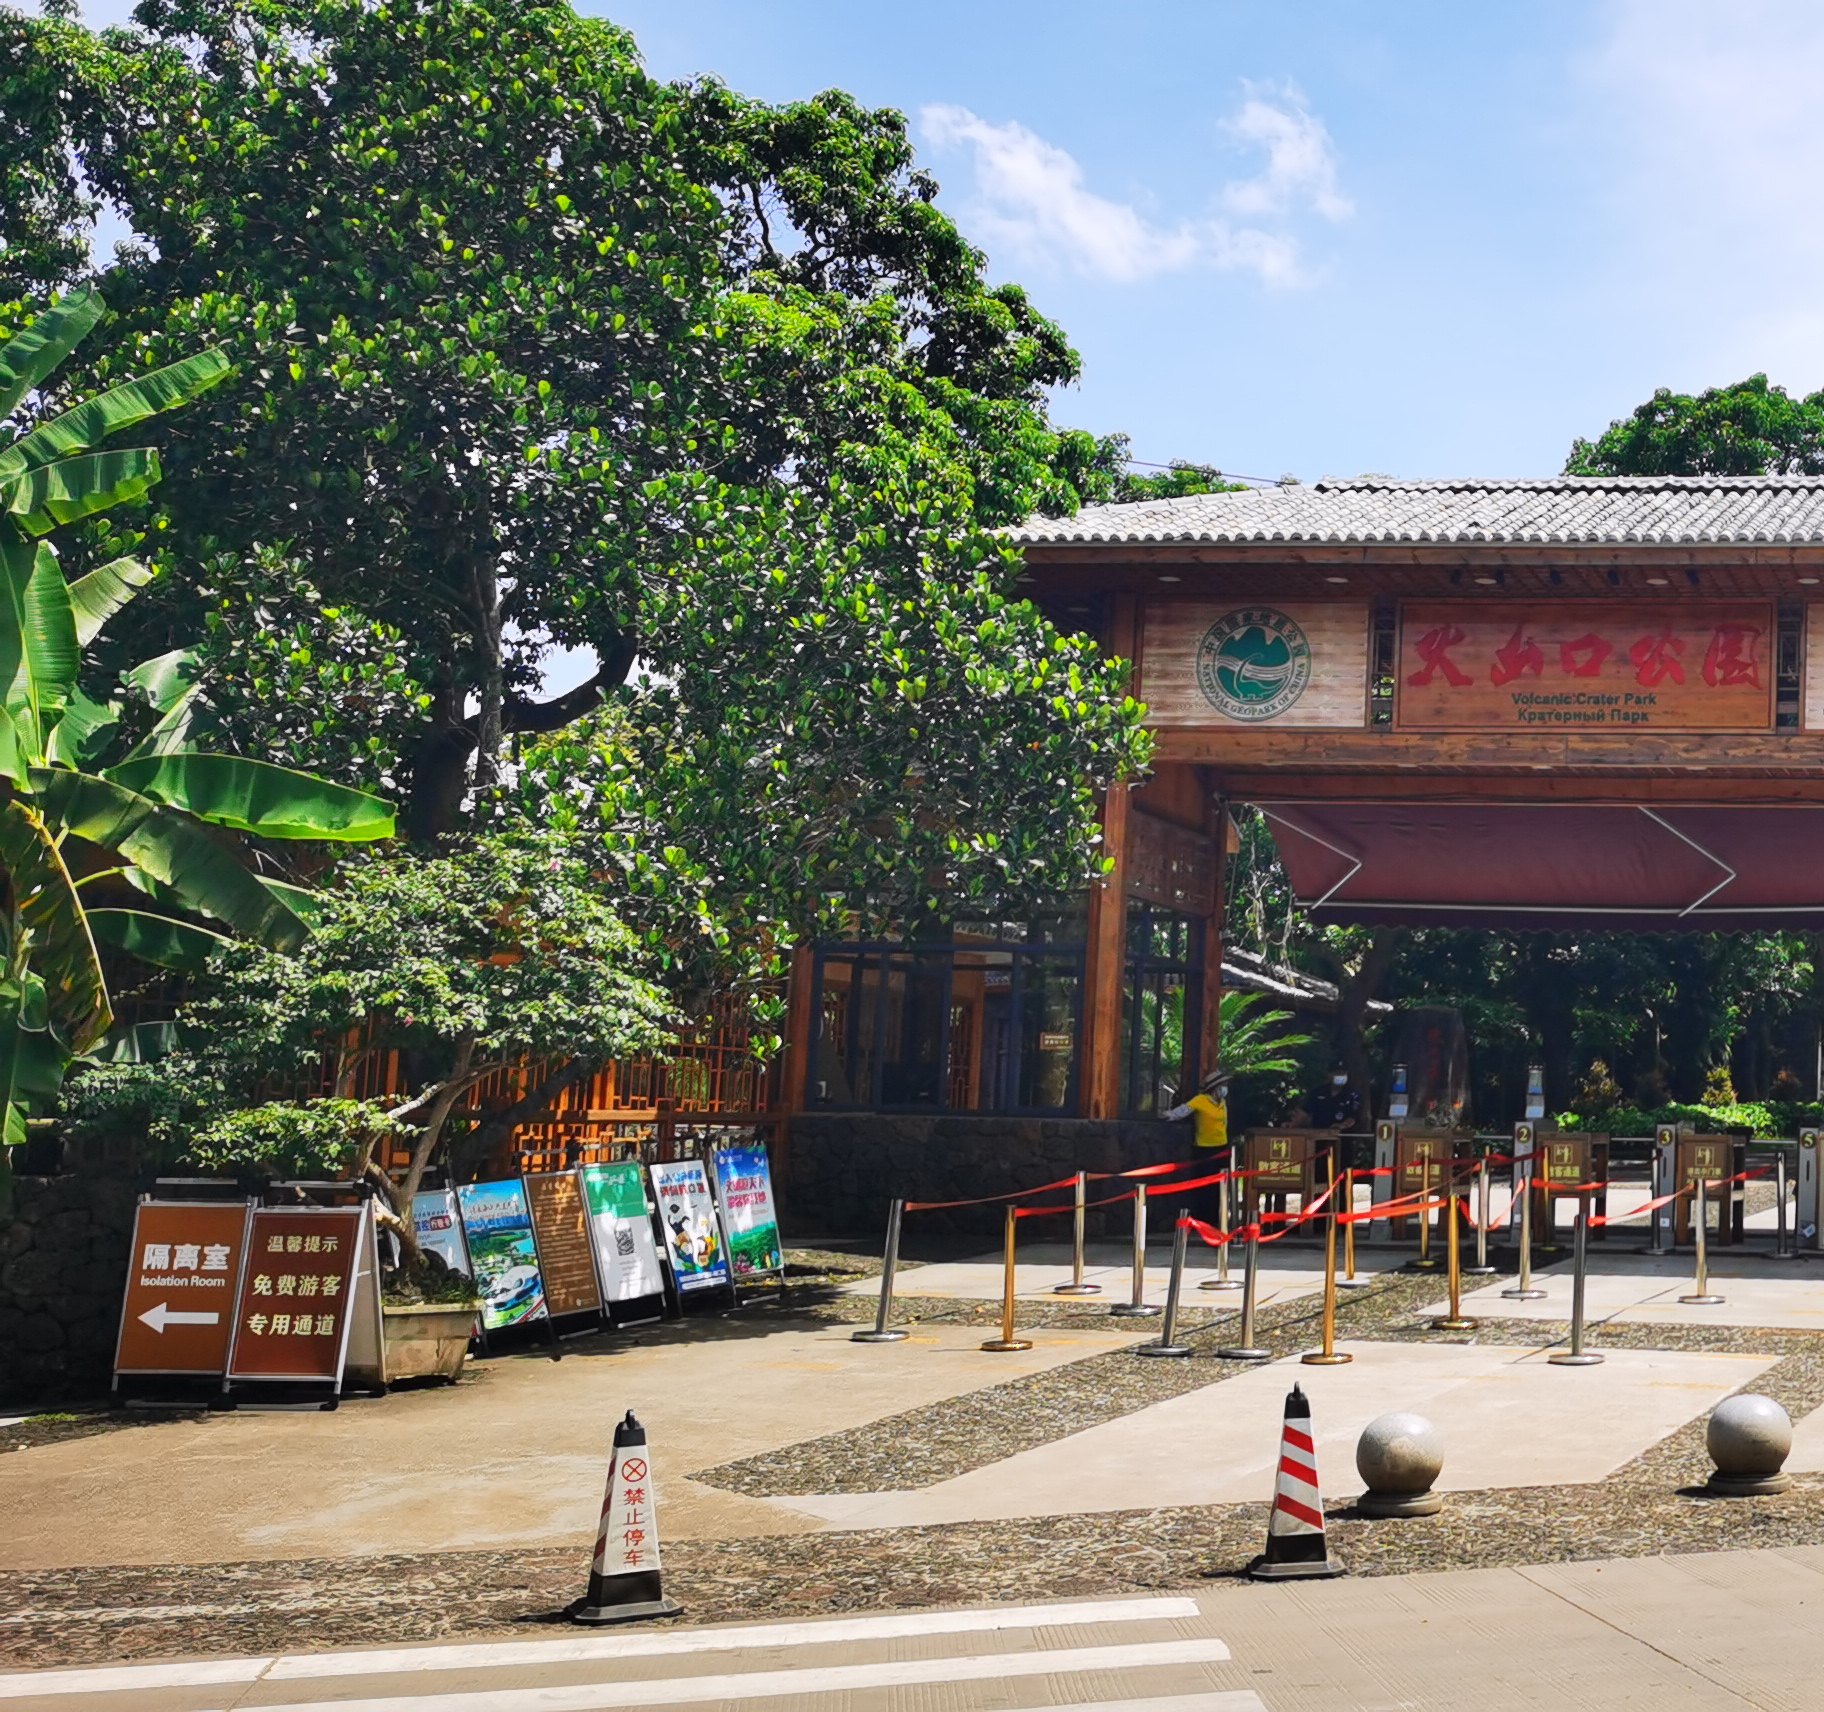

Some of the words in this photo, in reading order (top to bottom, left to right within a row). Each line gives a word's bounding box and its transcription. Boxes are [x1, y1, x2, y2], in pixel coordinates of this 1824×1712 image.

[1407, 621, 1765, 691] 火山口公园
[1230, 703, 1278, 716] GEOPARK
[1511, 692, 1572, 705] Volcanic
[1577, 692, 1620, 705] Crater
[1625, 692, 1657, 705] Park
[1518, 708, 1605, 723] Кратерный
[1611, 709, 1649, 723] Парк
[267, 1234, 339, 1254] 温馨提示
[142, 1243, 231, 1271] 隔离室
[140, 1275, 188, 1287] Isolation
[191, 1276, 225, 1288] Room
[252, 1273, 342, 1297] 免费游客
[247, 1312, 336, 1337] 专用通道
[622, 1487, 647, 1568] 禁止停车
